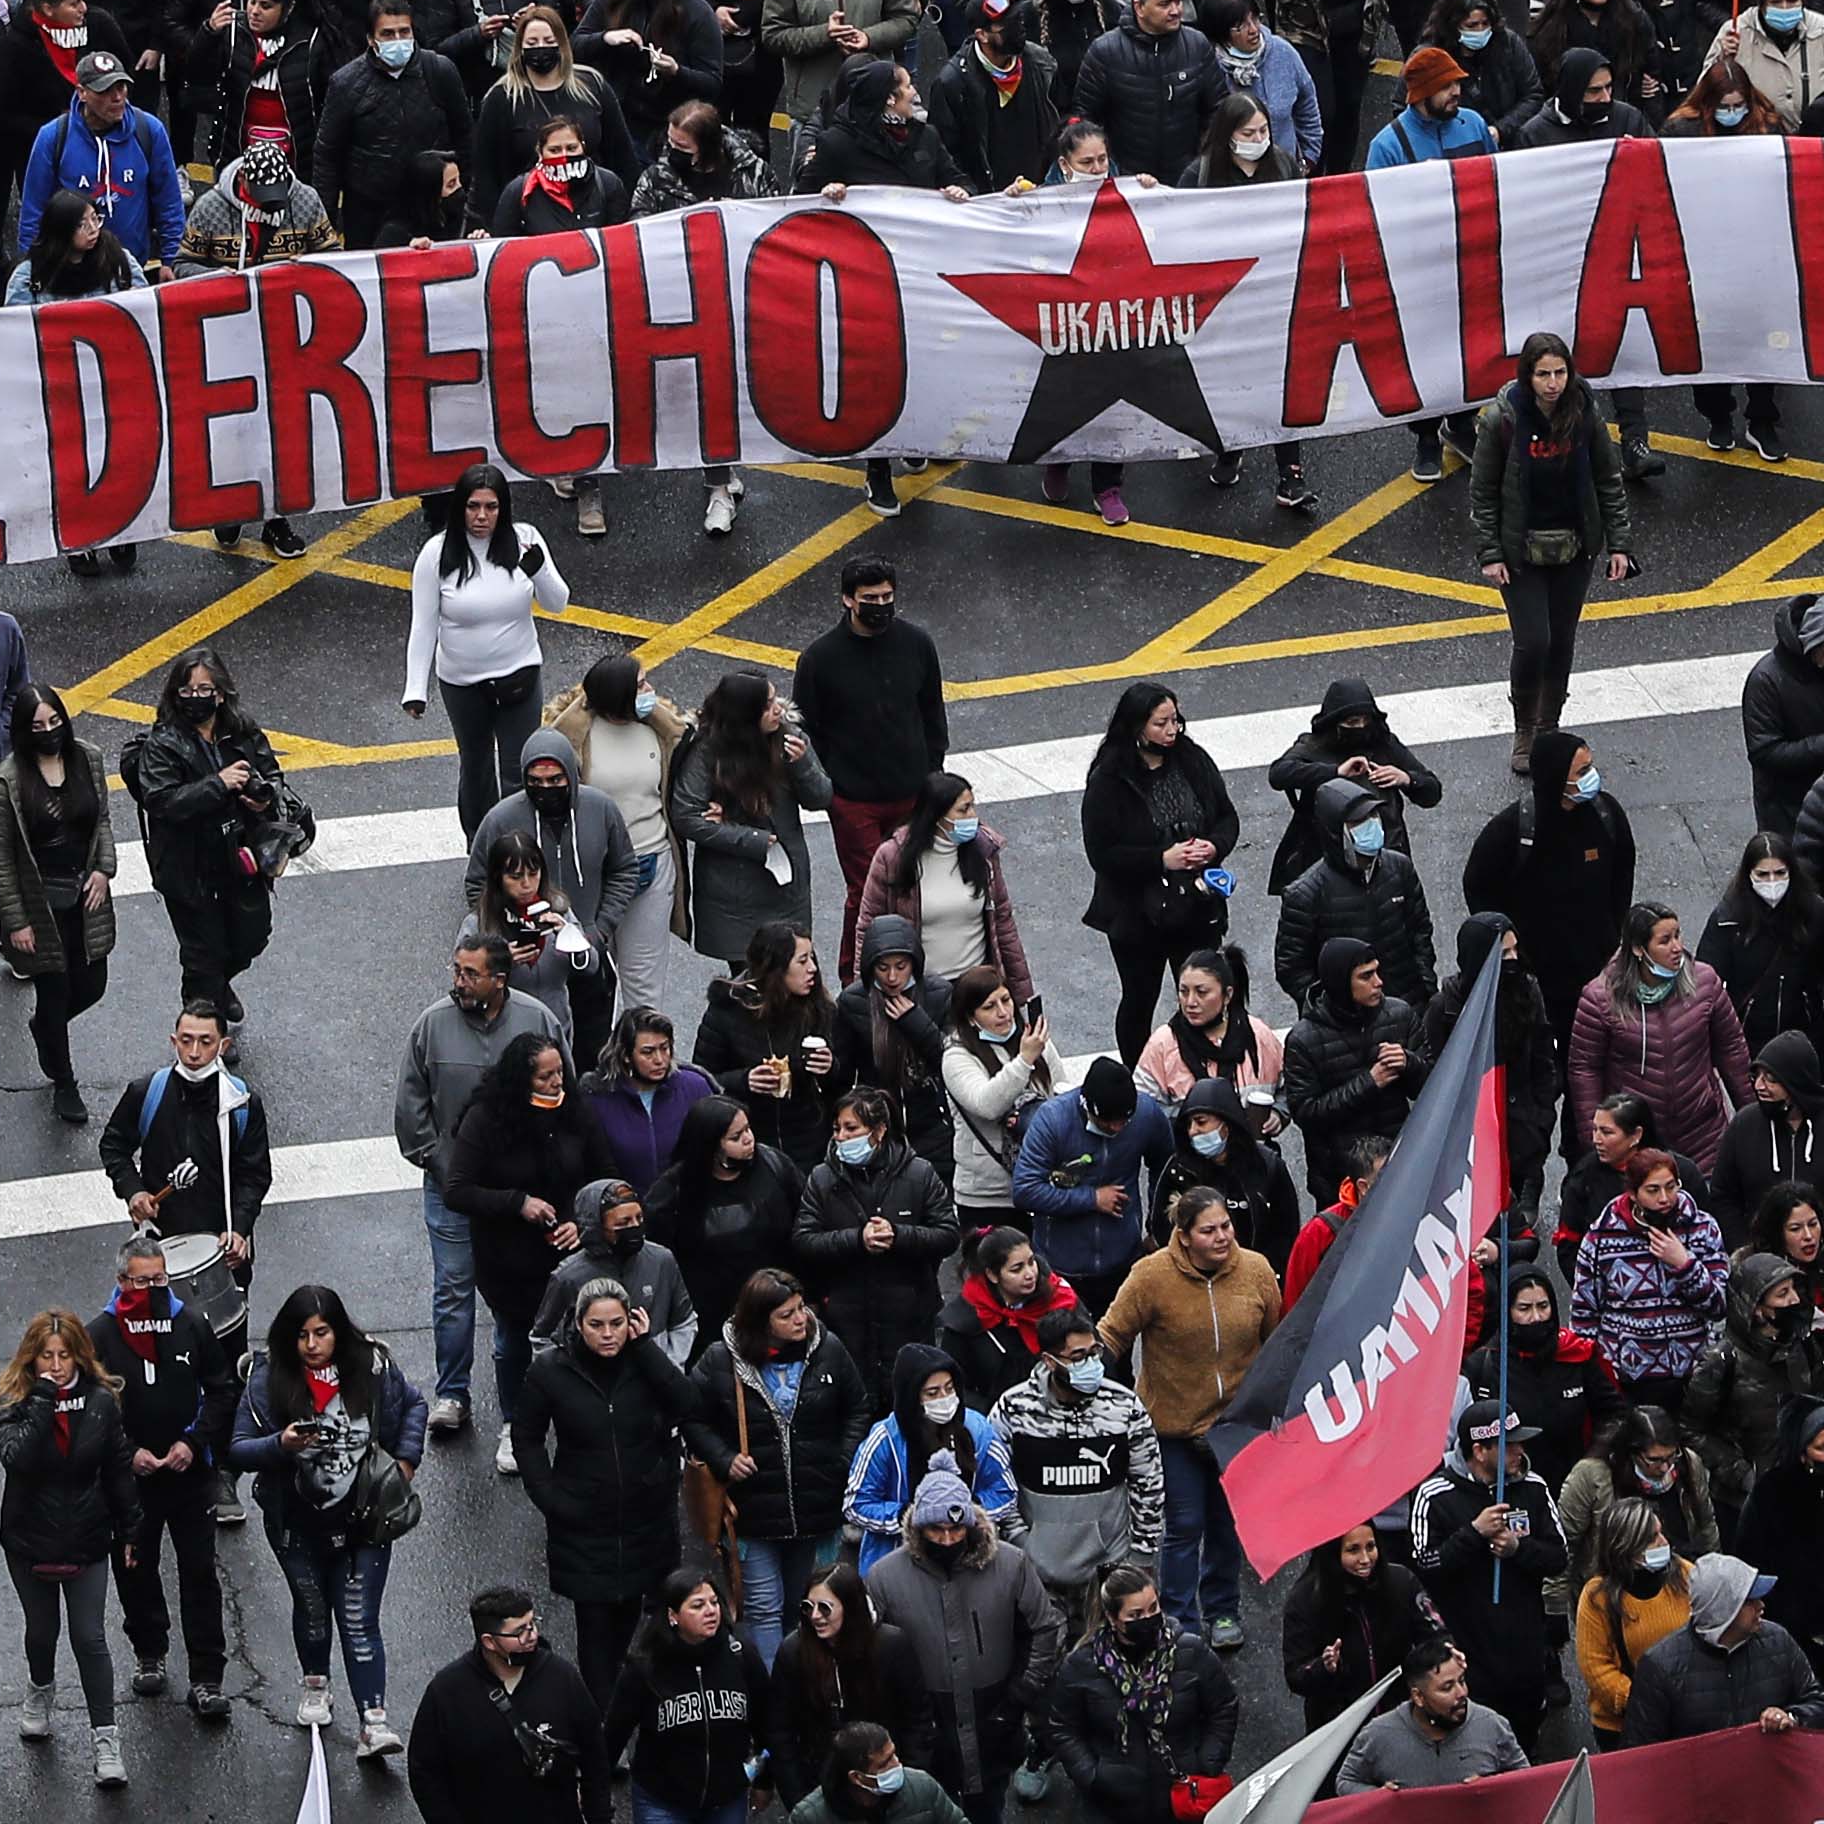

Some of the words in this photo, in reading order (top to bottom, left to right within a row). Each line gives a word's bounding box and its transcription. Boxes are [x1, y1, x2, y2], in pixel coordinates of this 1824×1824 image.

[1038, 293, 1197, 356] UKAMAU
[1282, 171, 1423, 428] A
[1450, 138, 1703, 403] LA
[35, 207, 908, 551] DERECHO
[1042, 1465, 1101, 1486] PUMA
